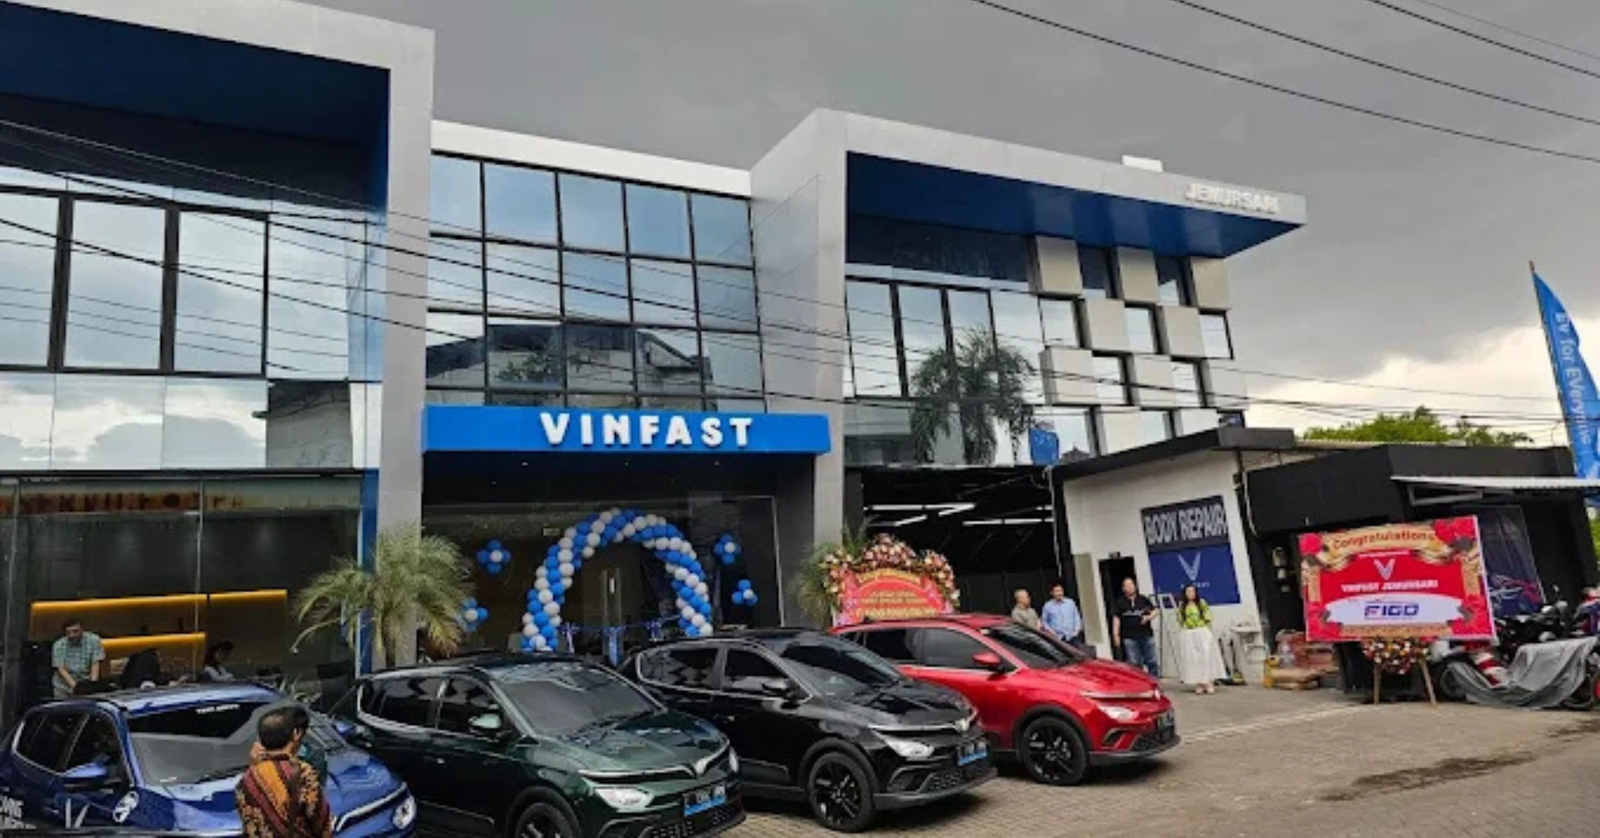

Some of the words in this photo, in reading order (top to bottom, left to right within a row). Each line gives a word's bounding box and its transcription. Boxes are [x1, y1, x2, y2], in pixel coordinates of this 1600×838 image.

[1559, 338, 1575, 362] for
[540, 412, 753, 447] VINFAST
[1144, 511, 1178, 546] BODY
[1178, 503, 1228, 541] REPAIR
[1332, 529, 1435, 550] Congratulations
[1364, 604, 1419, 617] FIGO
